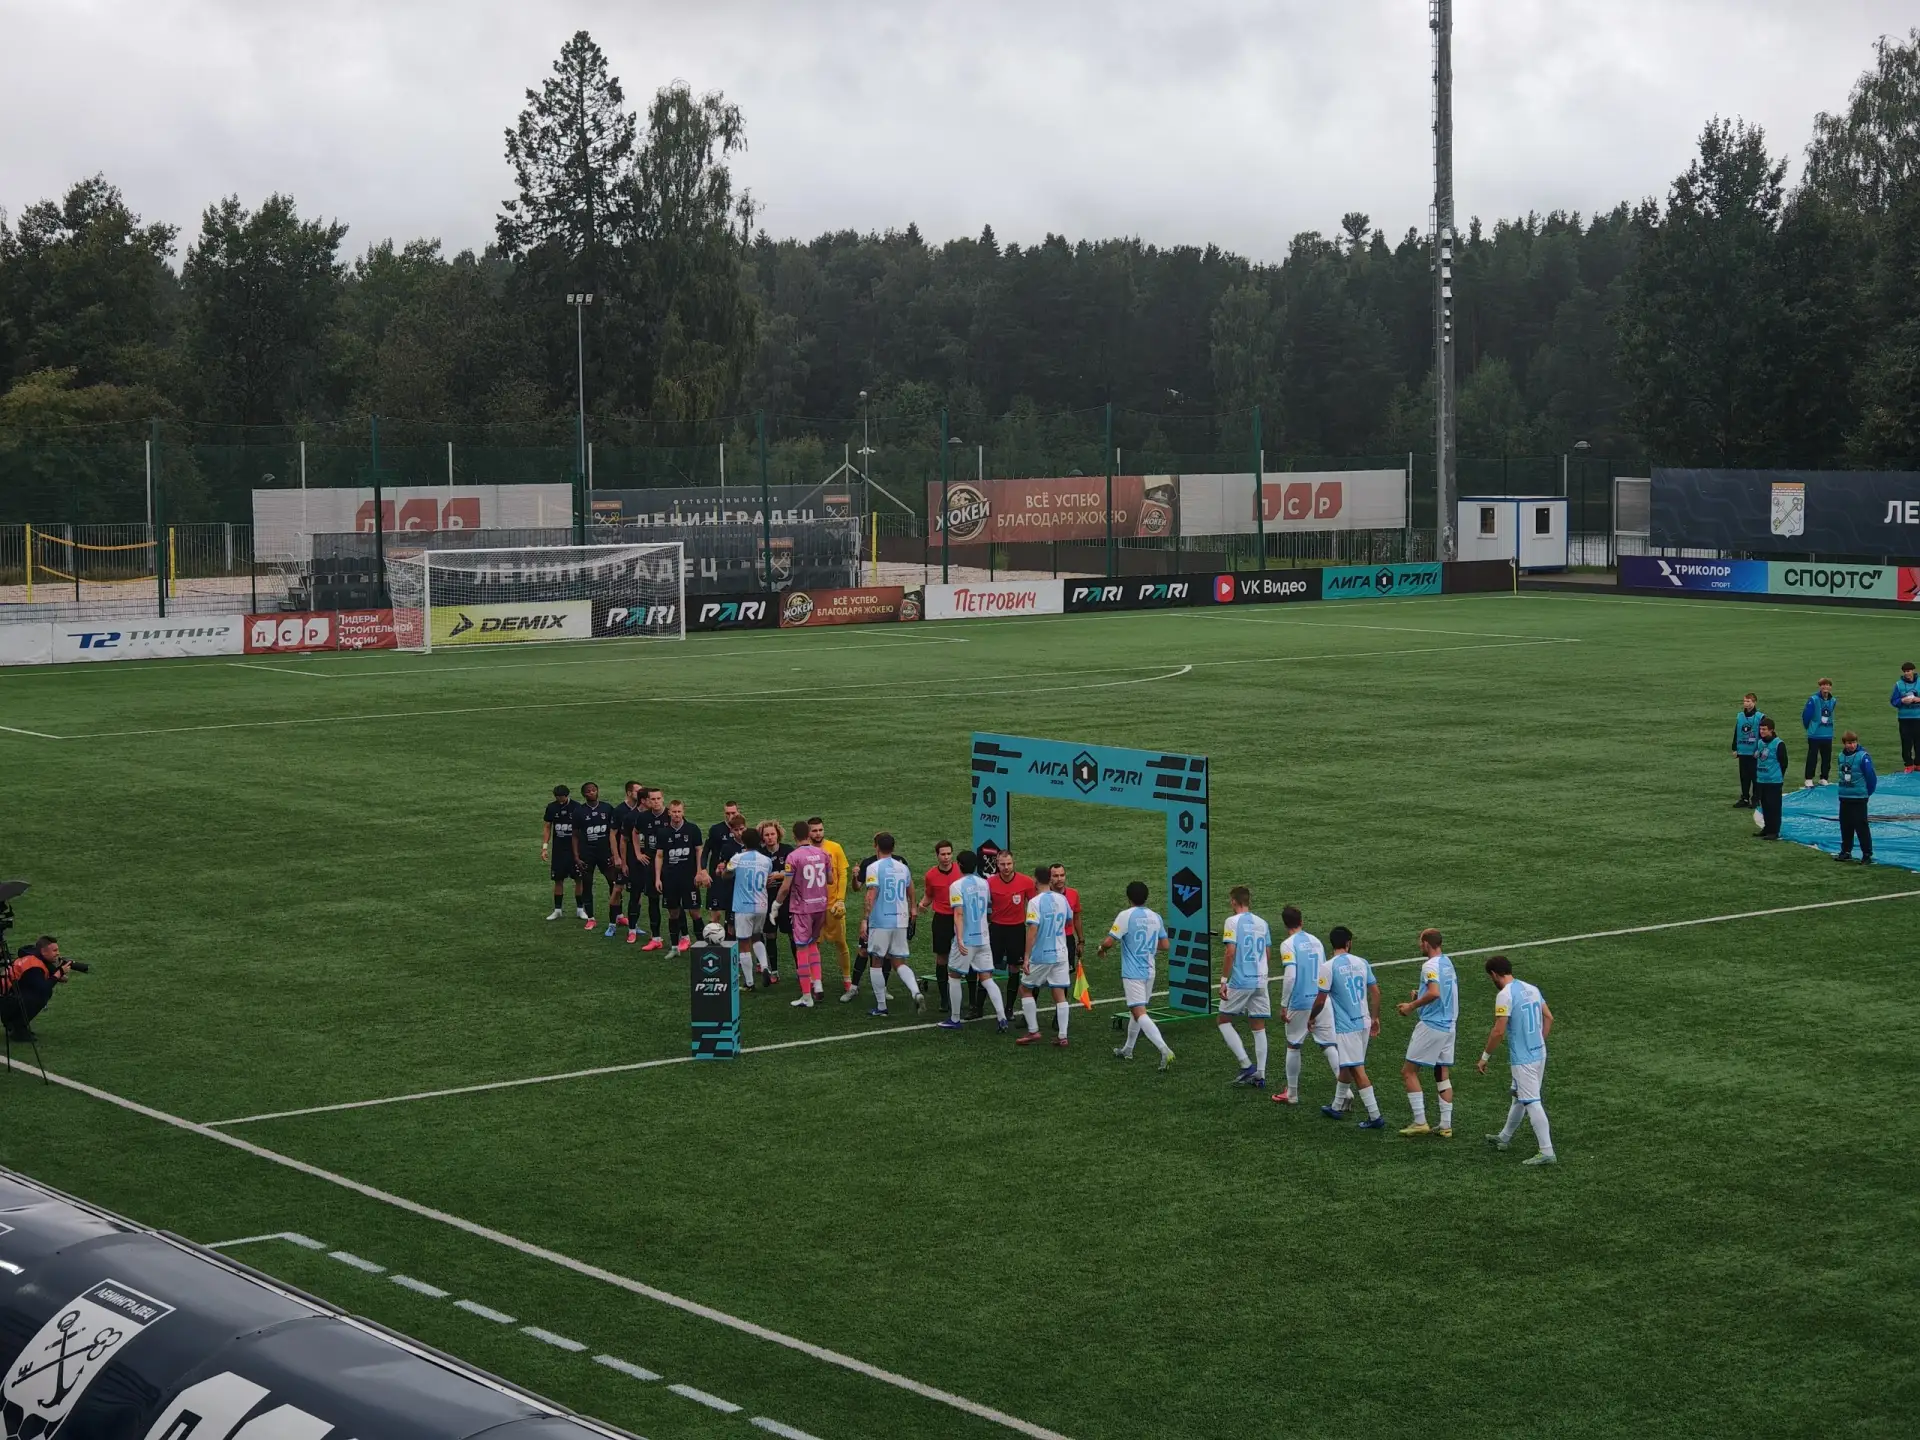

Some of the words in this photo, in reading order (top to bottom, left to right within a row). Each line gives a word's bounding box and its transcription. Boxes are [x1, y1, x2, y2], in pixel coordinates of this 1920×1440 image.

[751, 496, 778, 504] КЛБ
[1026, 491, 1050, 509] ВСЁ
[1054, 493, 1100, 508] УСПЕЮ
[997, 512, 1073, 528] БЛАГОДАРЯ
[1675, 564, 1731, 577] ТРИКОЛОР
[1072, 585, 1123, 602] PARI
[1139, 582, 1189, 600] PARI
[1241, 580, 1260, 595] VK
[1263, 579, 1307, 597] Видео
[833, 595, 847, 605] ВСЁ
[850, 596, 878, 605] УСПЕЮ
[699, 601, 766, 623] PARI
[817, 606, 863, 617] БЛАГОДАРЯ
[864, 605, 894, 615] ЖОКЕЮ
[480, 614, 569, 633] DEMIX
[1028, 760, 1068, 777] ЛИГА
[1102, 768, 1143, 786] PARI
[745, 868, 765, 892] 10
[803, 863, 826, 889] 93
[884, 876, 906, 903] 50
[1043, 912, 1065, 938] 72
[1134, 929, 1159, 956] 24
[1243, 934, 1265, 964] 29
[1344, 975, 1365, 1006] 18
